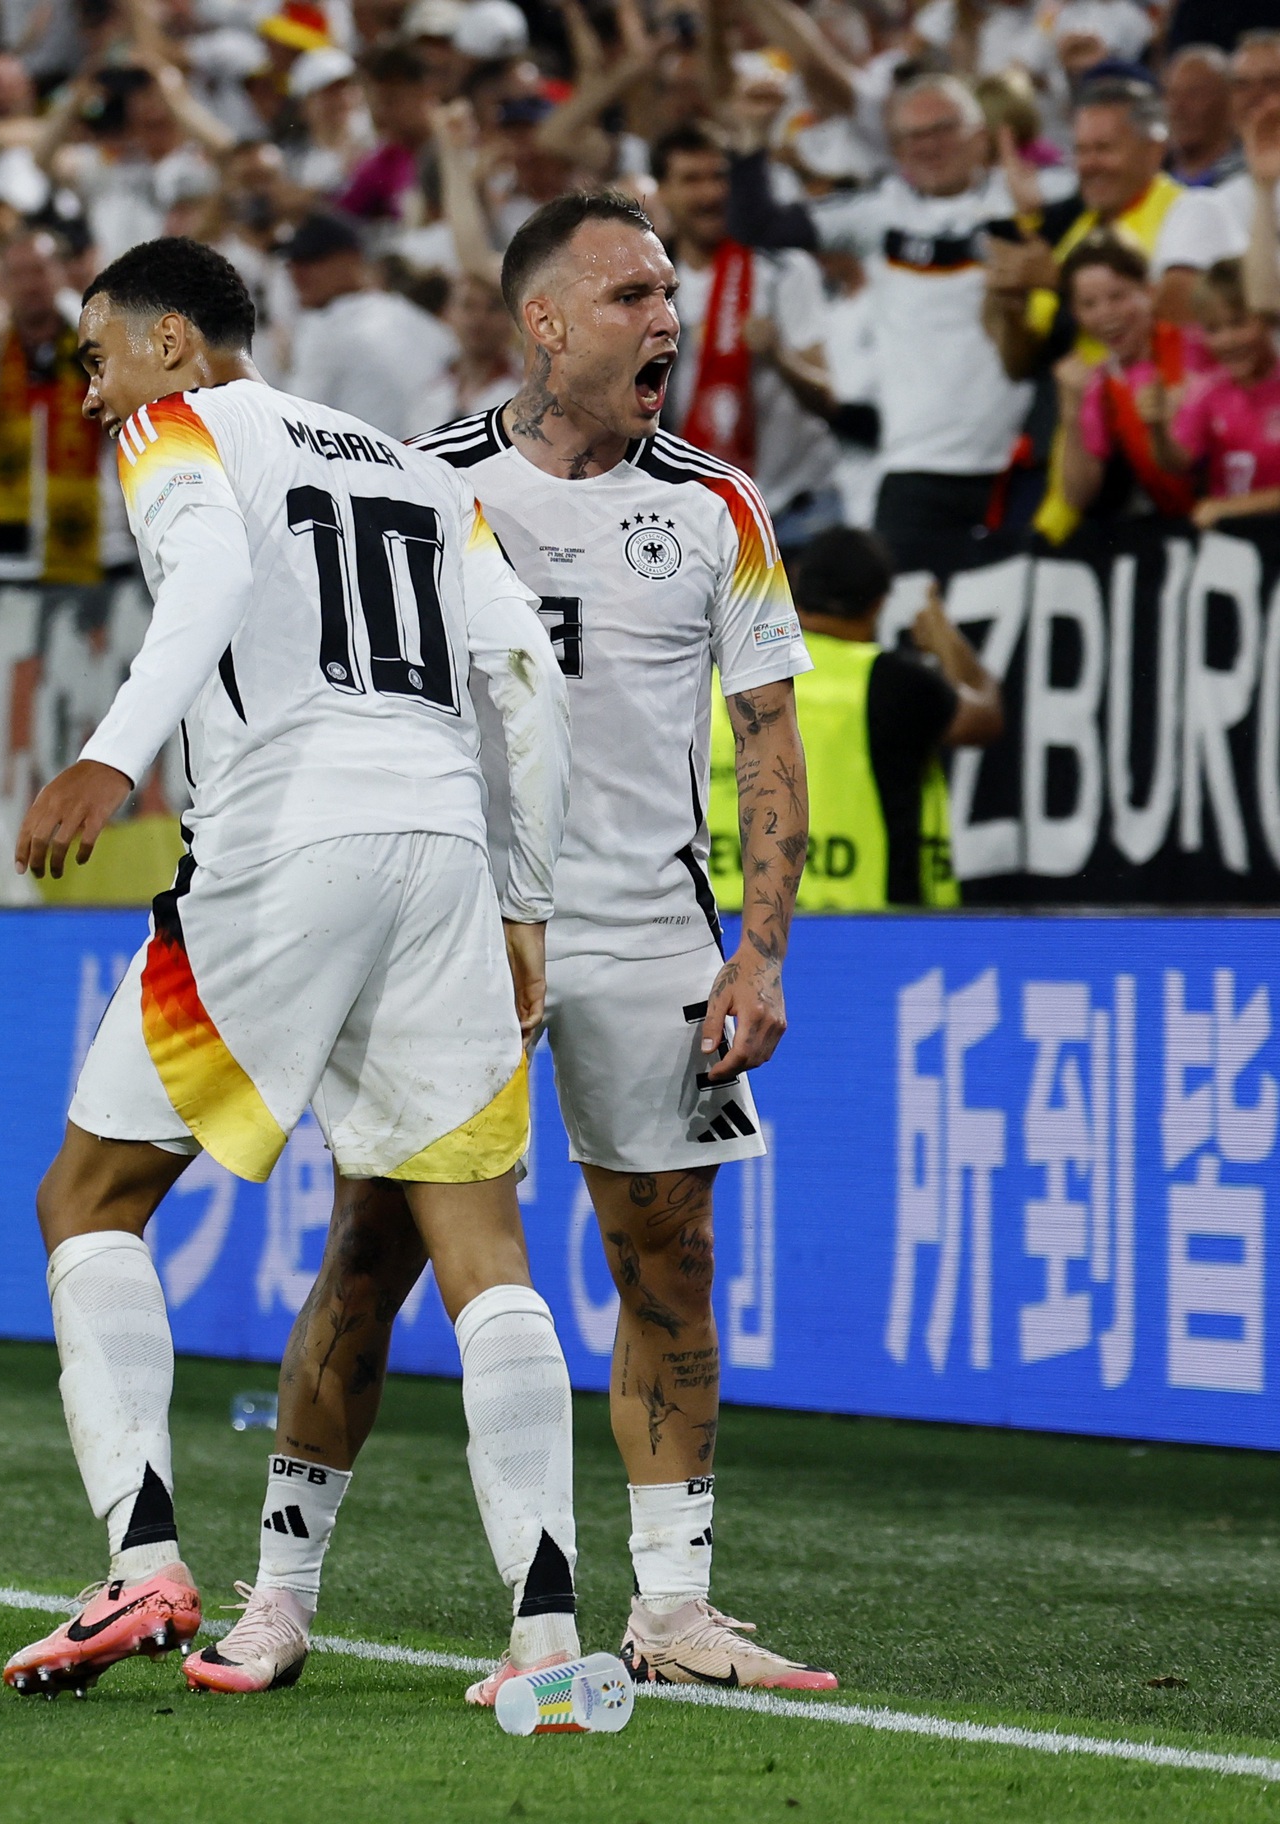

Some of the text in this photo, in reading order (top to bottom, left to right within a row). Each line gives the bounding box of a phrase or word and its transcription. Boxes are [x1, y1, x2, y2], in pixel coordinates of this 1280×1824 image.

[286, 485, 461, 717] 10
[635, 533, 668, 545] DEUTSCHER
[876, 531, 1280, 881] ZBUR
[272, 1457, 328, 1486] DFB
